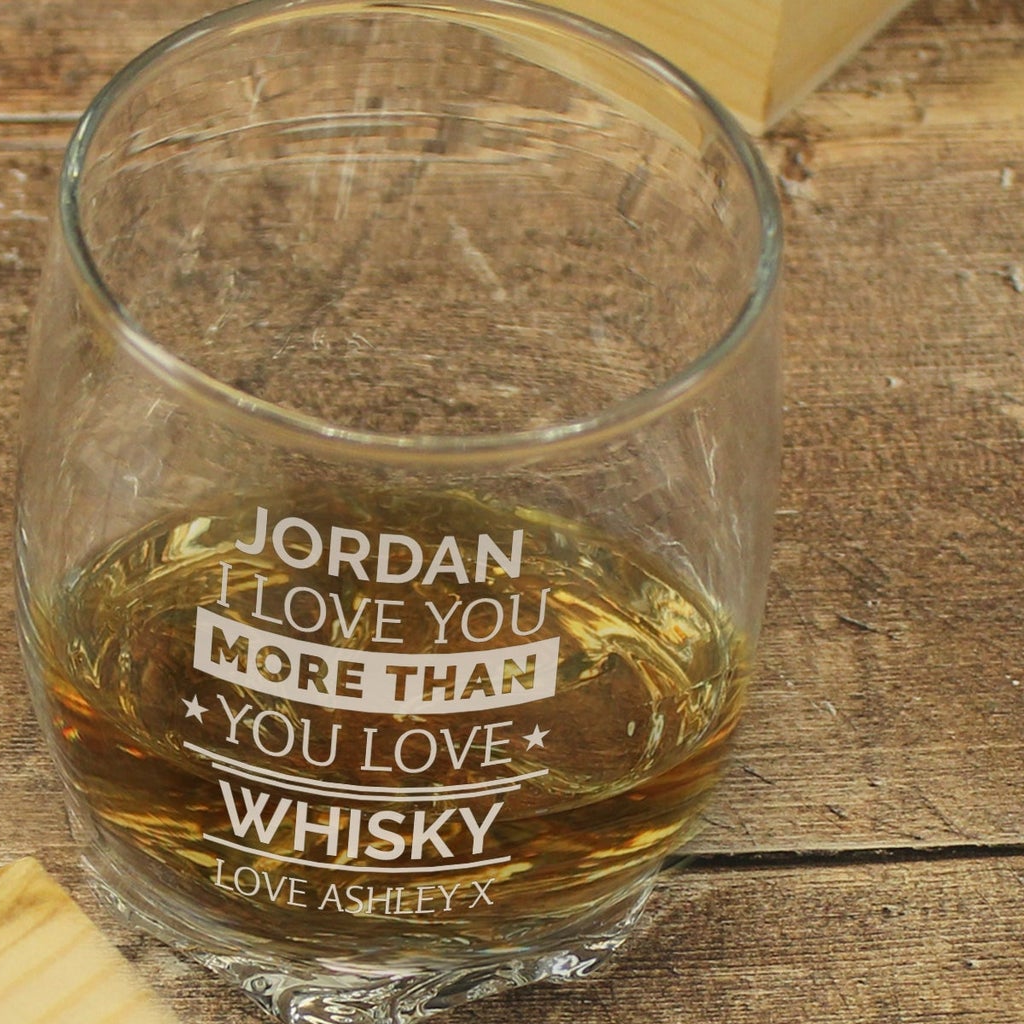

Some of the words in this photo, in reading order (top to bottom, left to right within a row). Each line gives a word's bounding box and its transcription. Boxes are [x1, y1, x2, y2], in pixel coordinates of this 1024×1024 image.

[234, 506, 524, 585] JORDAN
[216, 561, 232, 608] I
[251, 573, 405, 644] LOVE
[425, 588, 551, 644] YOU
[210, 625, 365, 699] MORE
[385, 653, 537, 702] THAN
[217, 693, 342, 767] YOU
[360, 720, 513, 774] LOVE
[218, 779, 505, 861] WHISKY
[214, 858, 308, 907] LOVE
[318, 882, 460, 915] ASHLEY
[469, 878, 495, 908] X
